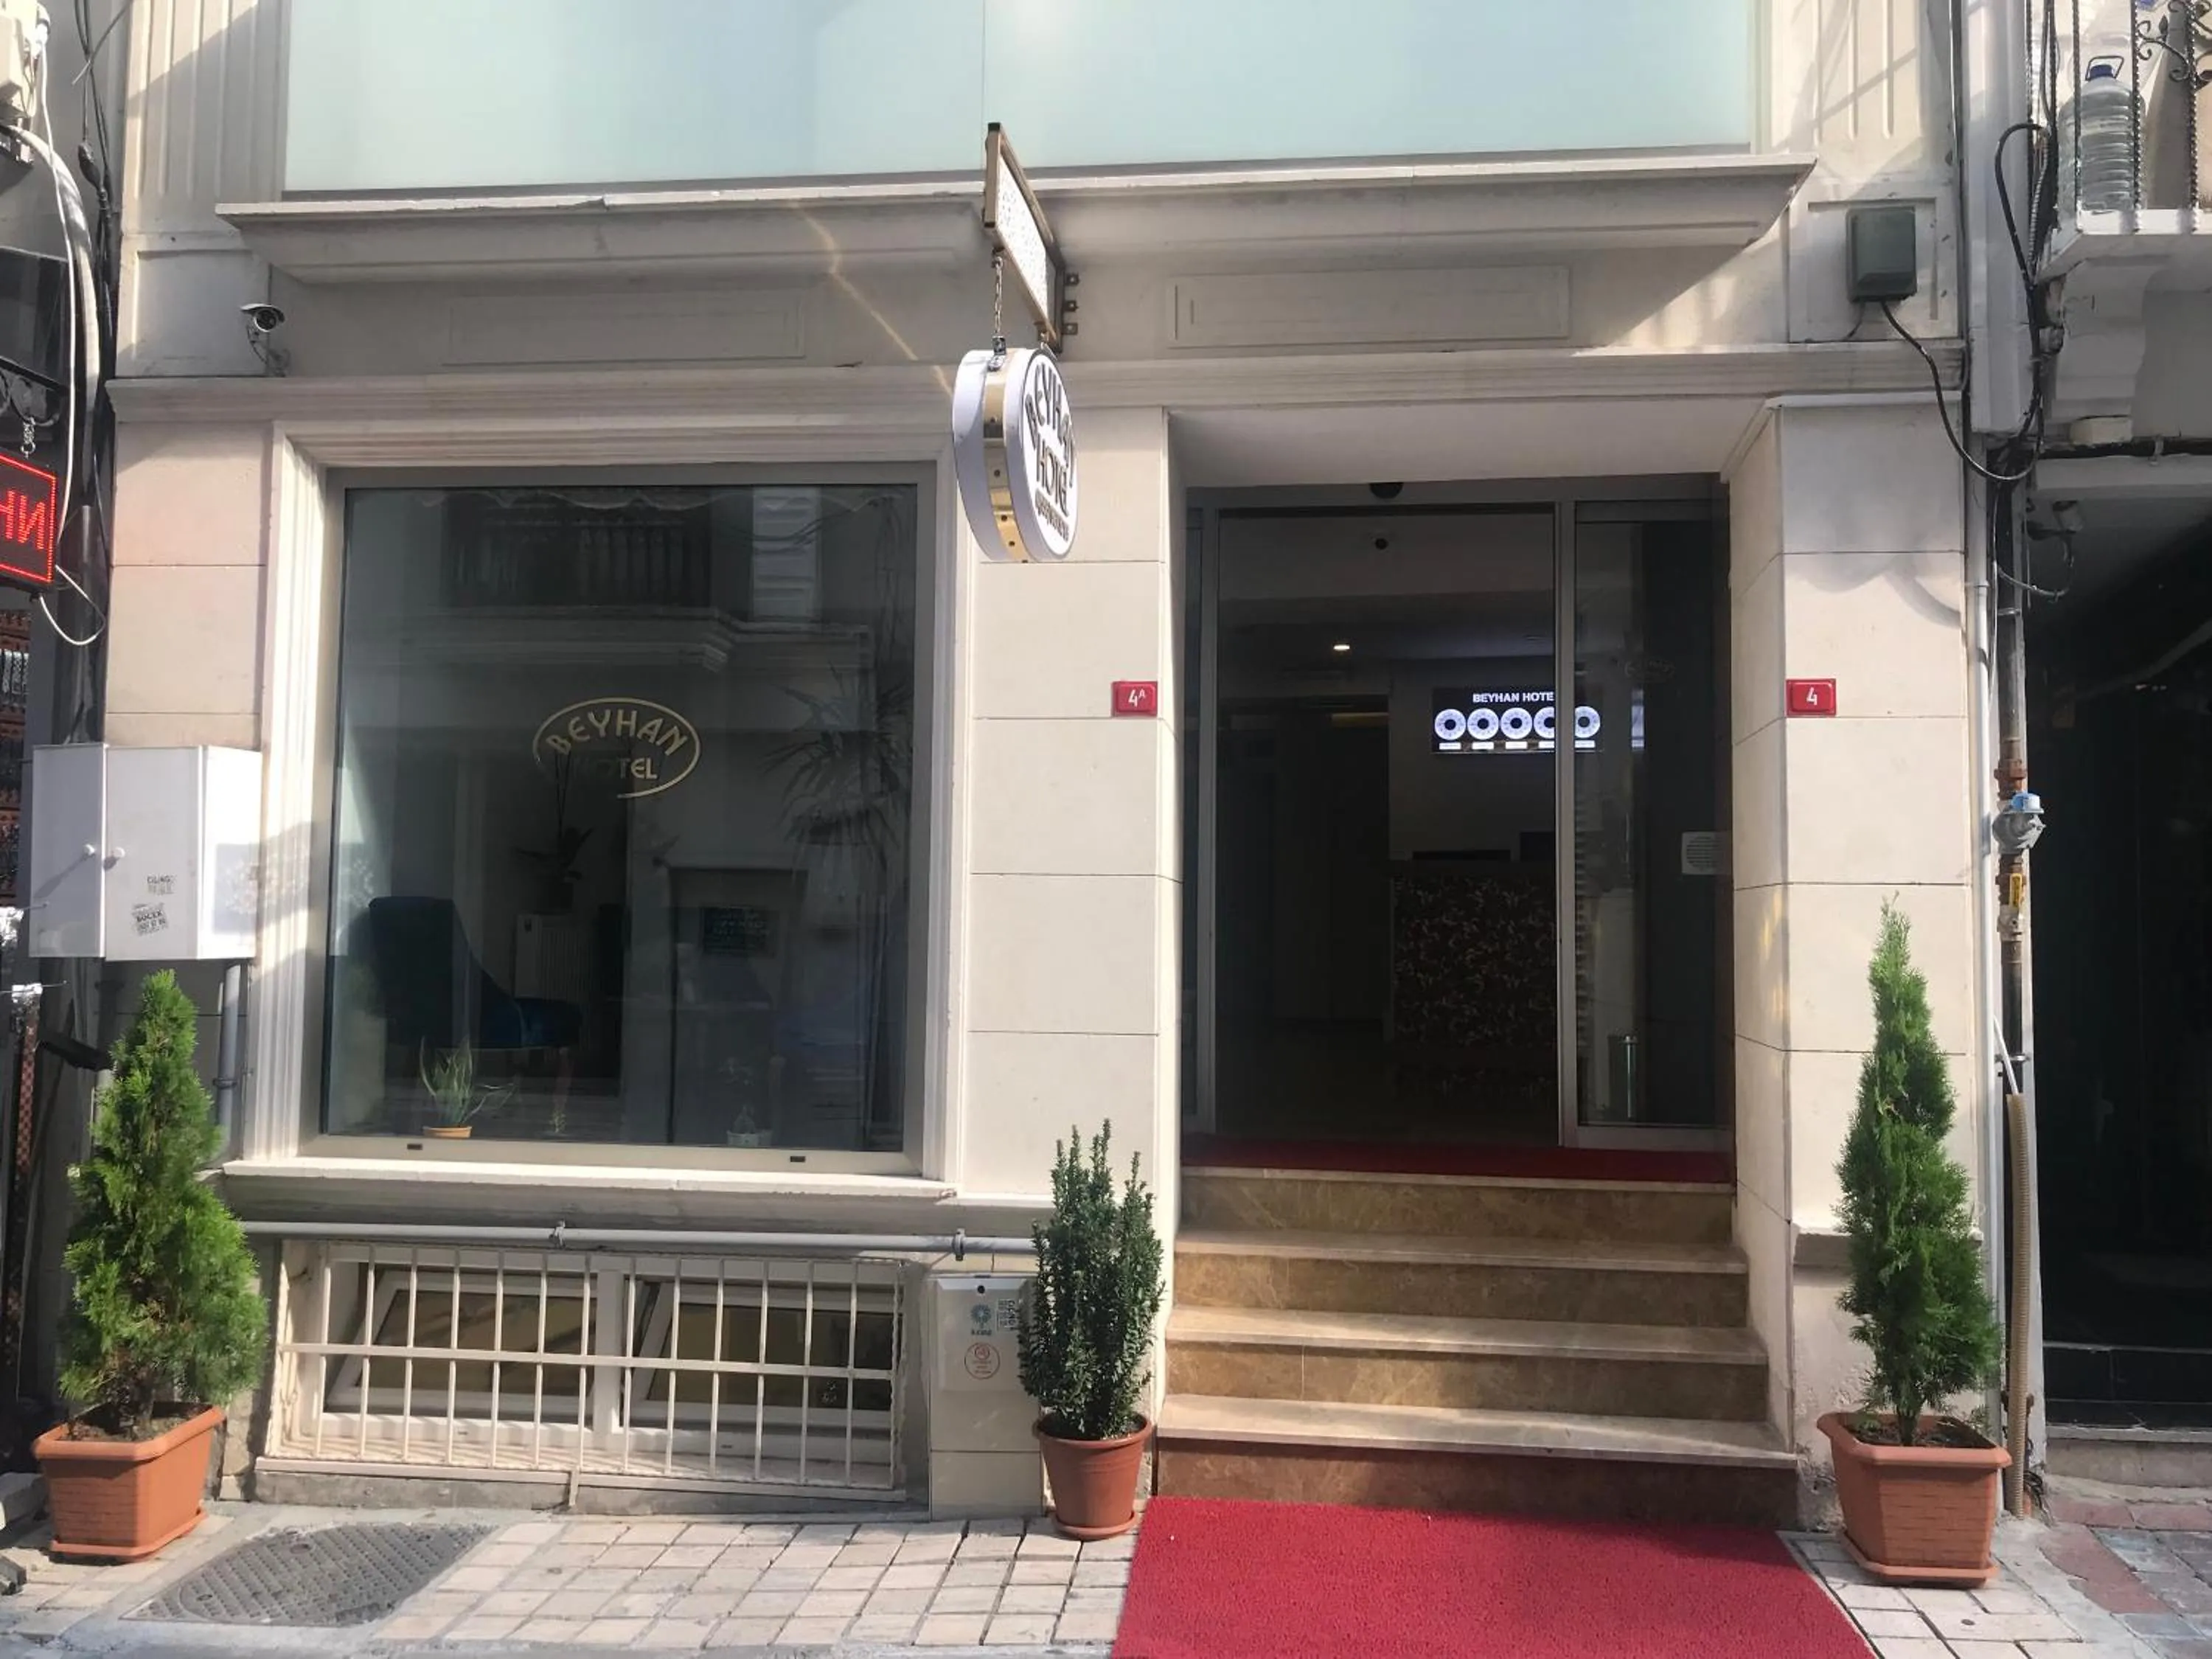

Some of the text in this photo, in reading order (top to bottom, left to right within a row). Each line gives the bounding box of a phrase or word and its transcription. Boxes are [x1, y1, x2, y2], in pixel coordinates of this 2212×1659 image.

[1036, 433, 1069, 517] HOTEL
[1472, 691, 1554, 703] BEYHAN HOTE
[1806, 686, 1818, 706] 4
[546, 709, 688, 756] BEYHAN
